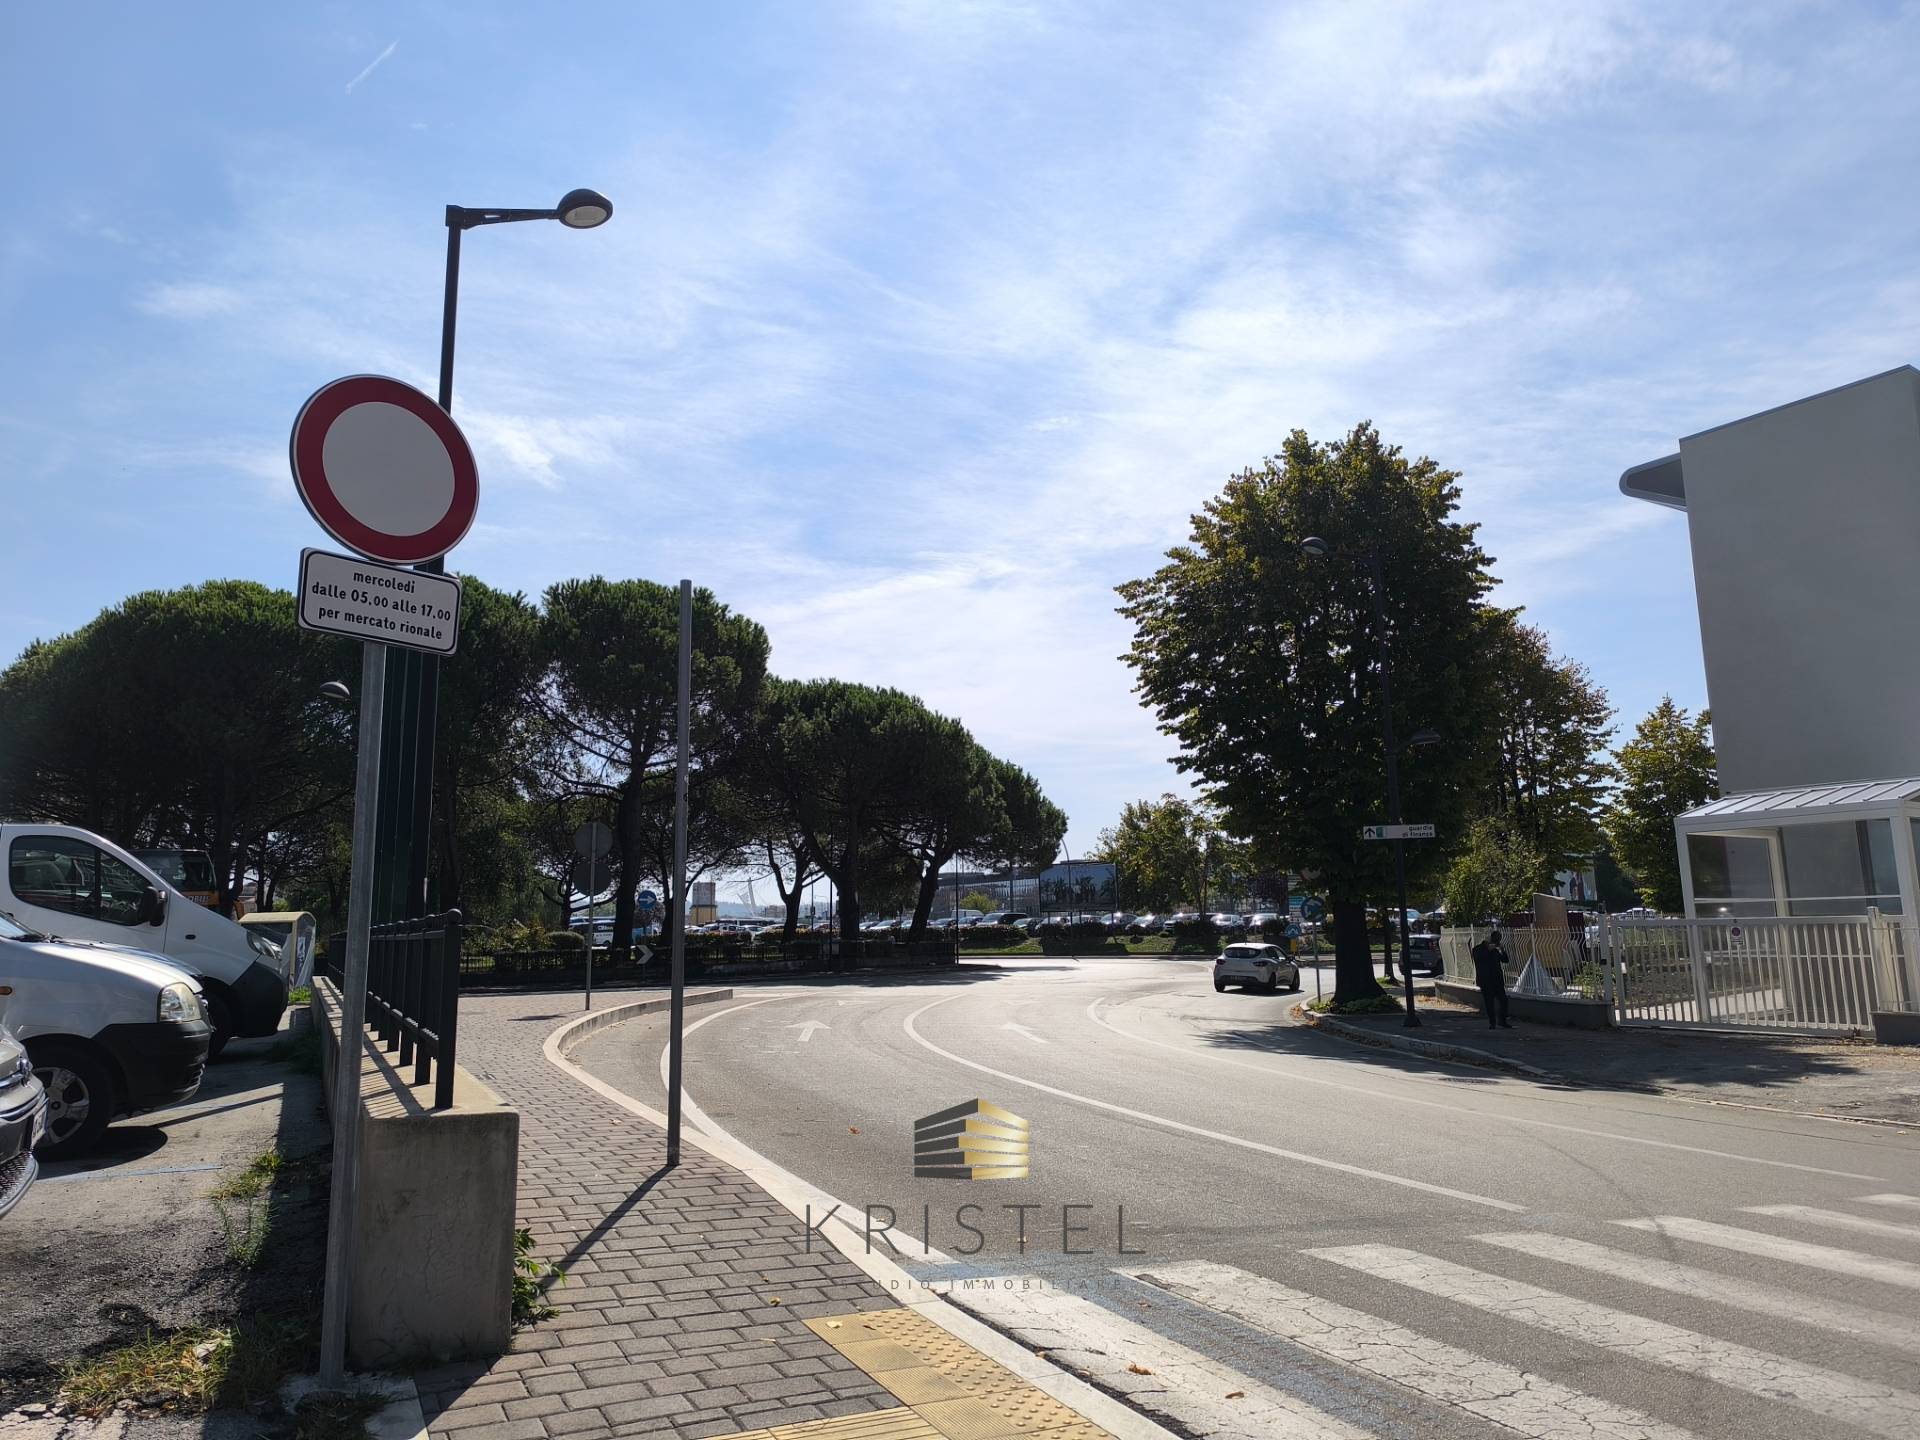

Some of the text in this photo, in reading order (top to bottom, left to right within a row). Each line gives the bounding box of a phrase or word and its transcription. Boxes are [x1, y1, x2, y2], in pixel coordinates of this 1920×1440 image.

[353, 572, 415, 593] mercoledi
[311, 581, 451, 621] dalle 05.00 alle 17.00
[318, 607, 442, 639] per mercato rionale
